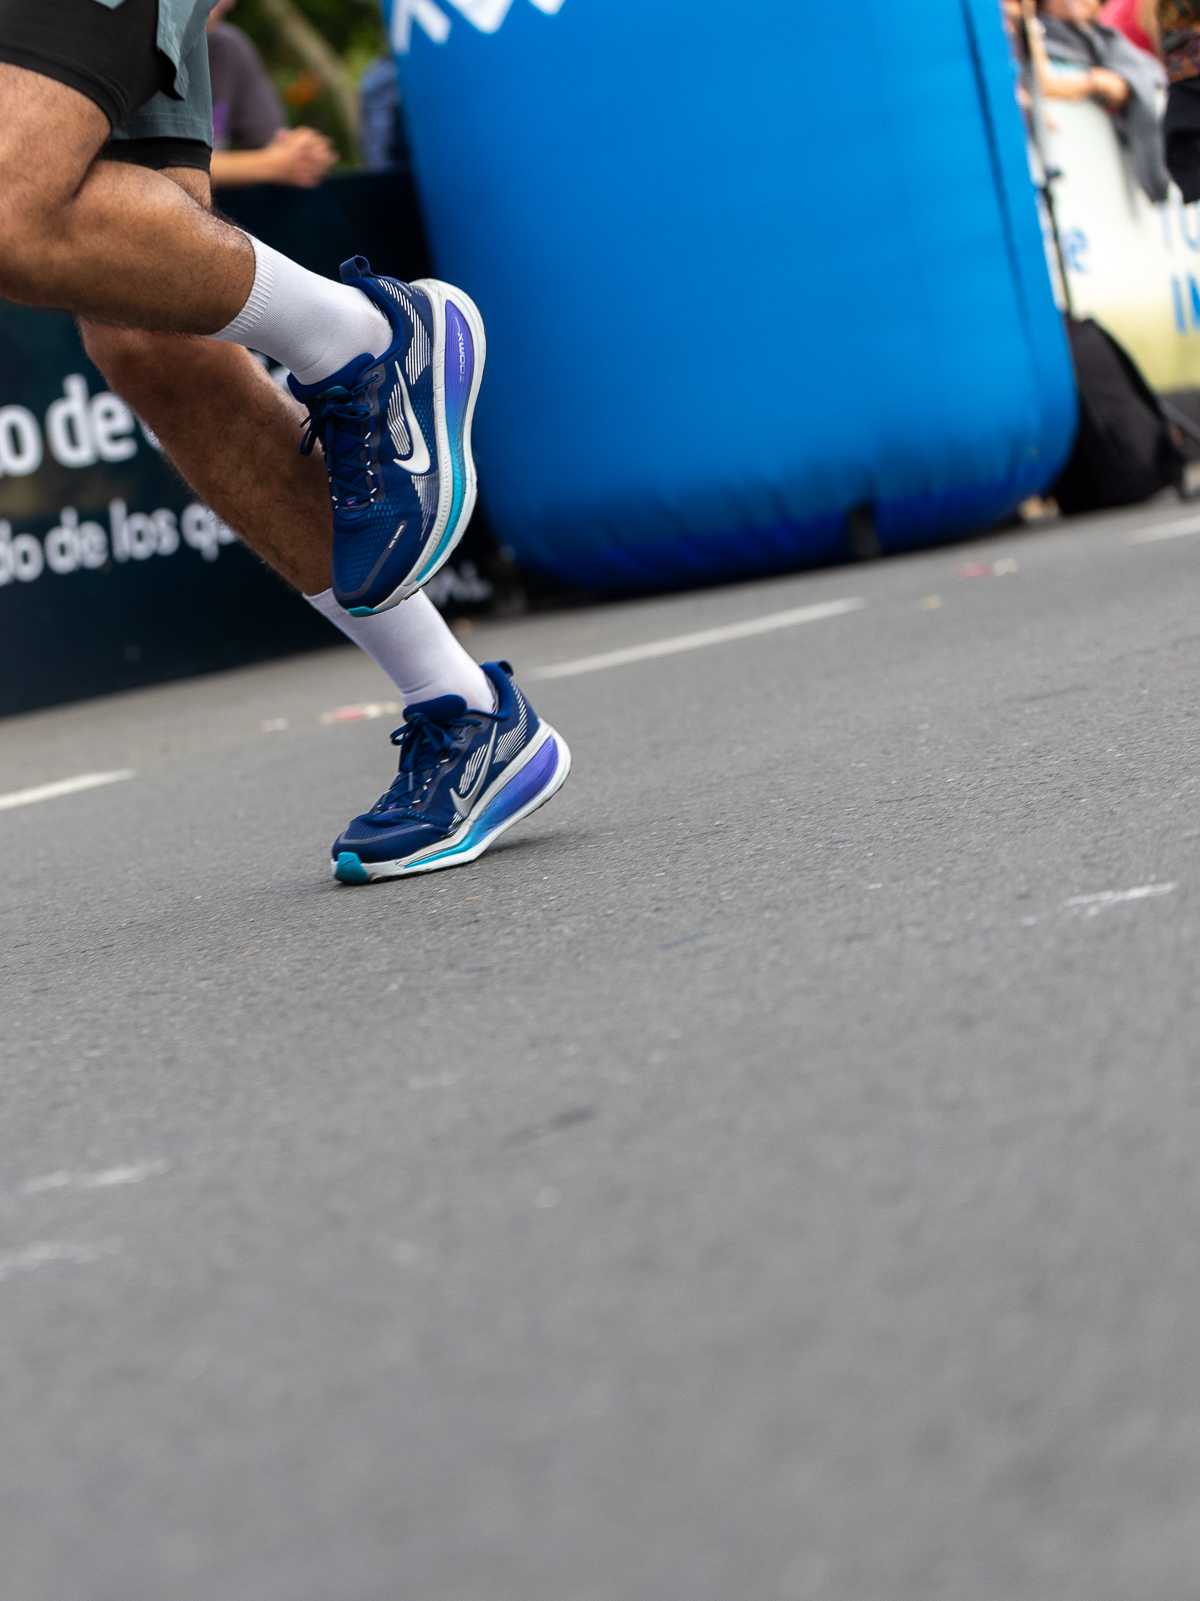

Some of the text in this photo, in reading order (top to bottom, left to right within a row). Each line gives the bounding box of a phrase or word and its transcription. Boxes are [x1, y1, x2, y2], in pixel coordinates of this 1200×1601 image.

[45, 373, 137, 467] de
[44, 506, 108, 574] de
[109, 498, 180, 563] los
